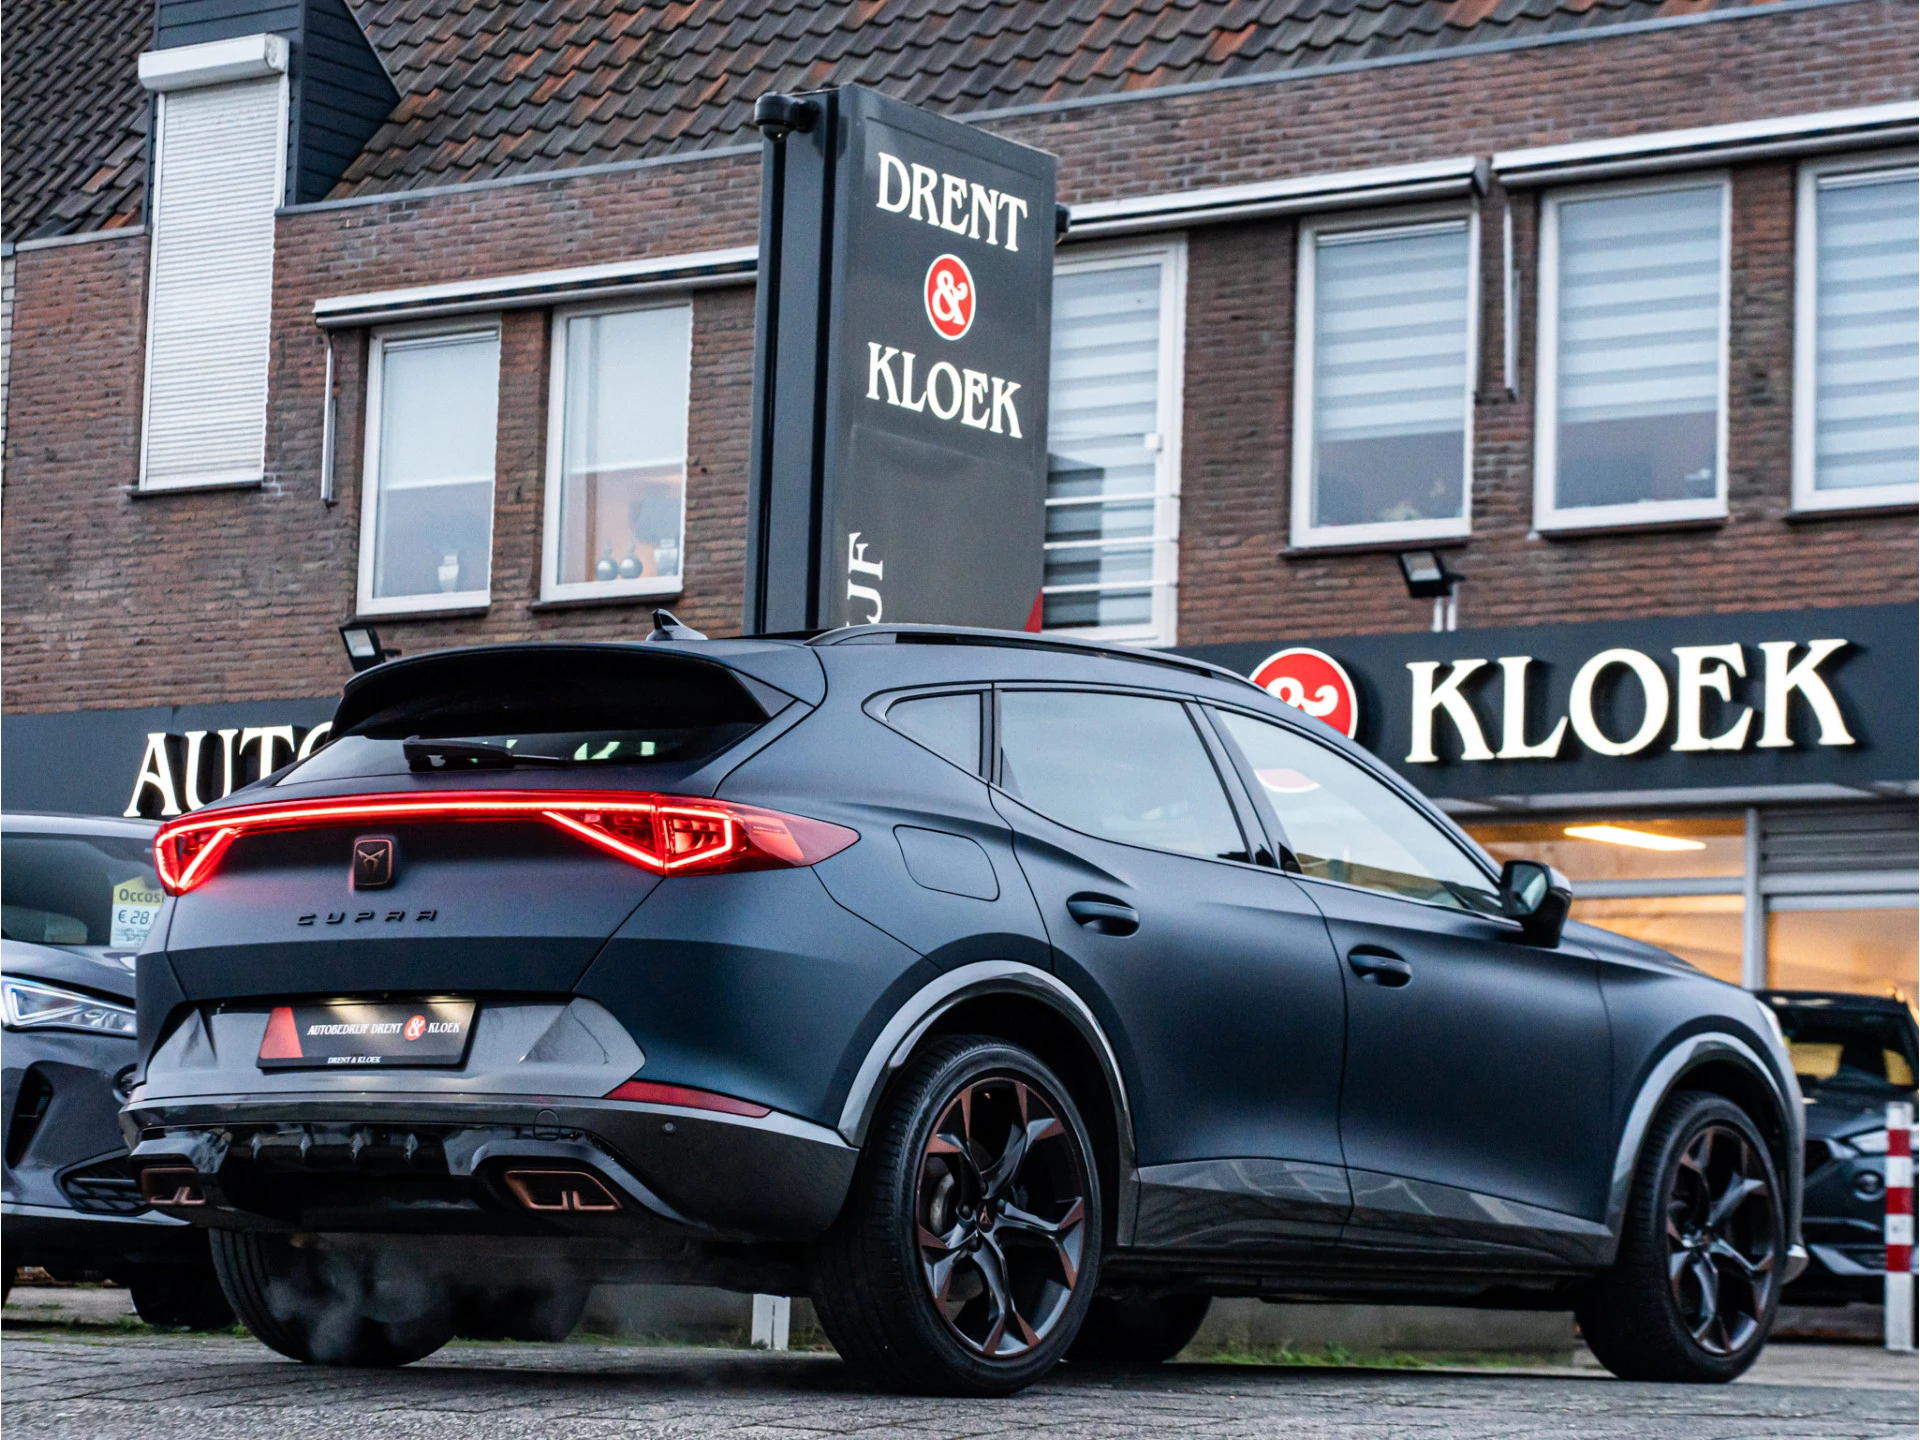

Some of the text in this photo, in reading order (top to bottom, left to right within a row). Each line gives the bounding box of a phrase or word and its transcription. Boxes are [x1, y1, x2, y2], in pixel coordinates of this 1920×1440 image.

[876, 151, 1028, 252] DRENT
[931, 269, 968, 325] &
[866, 341, 1022, 439] KLOEK
[846, 531, 884, 627] JF
[1405, 638, 1855, 763] KLOEK
[298, 909, 438, 926] CUPRA
[307, 1017, 461, 1037] AUTOBEDRIJF DRENT & KLOEK
[327, 1056, 350, 1064] DRENT
[357, 1056, 381, 1064] KLOEK
